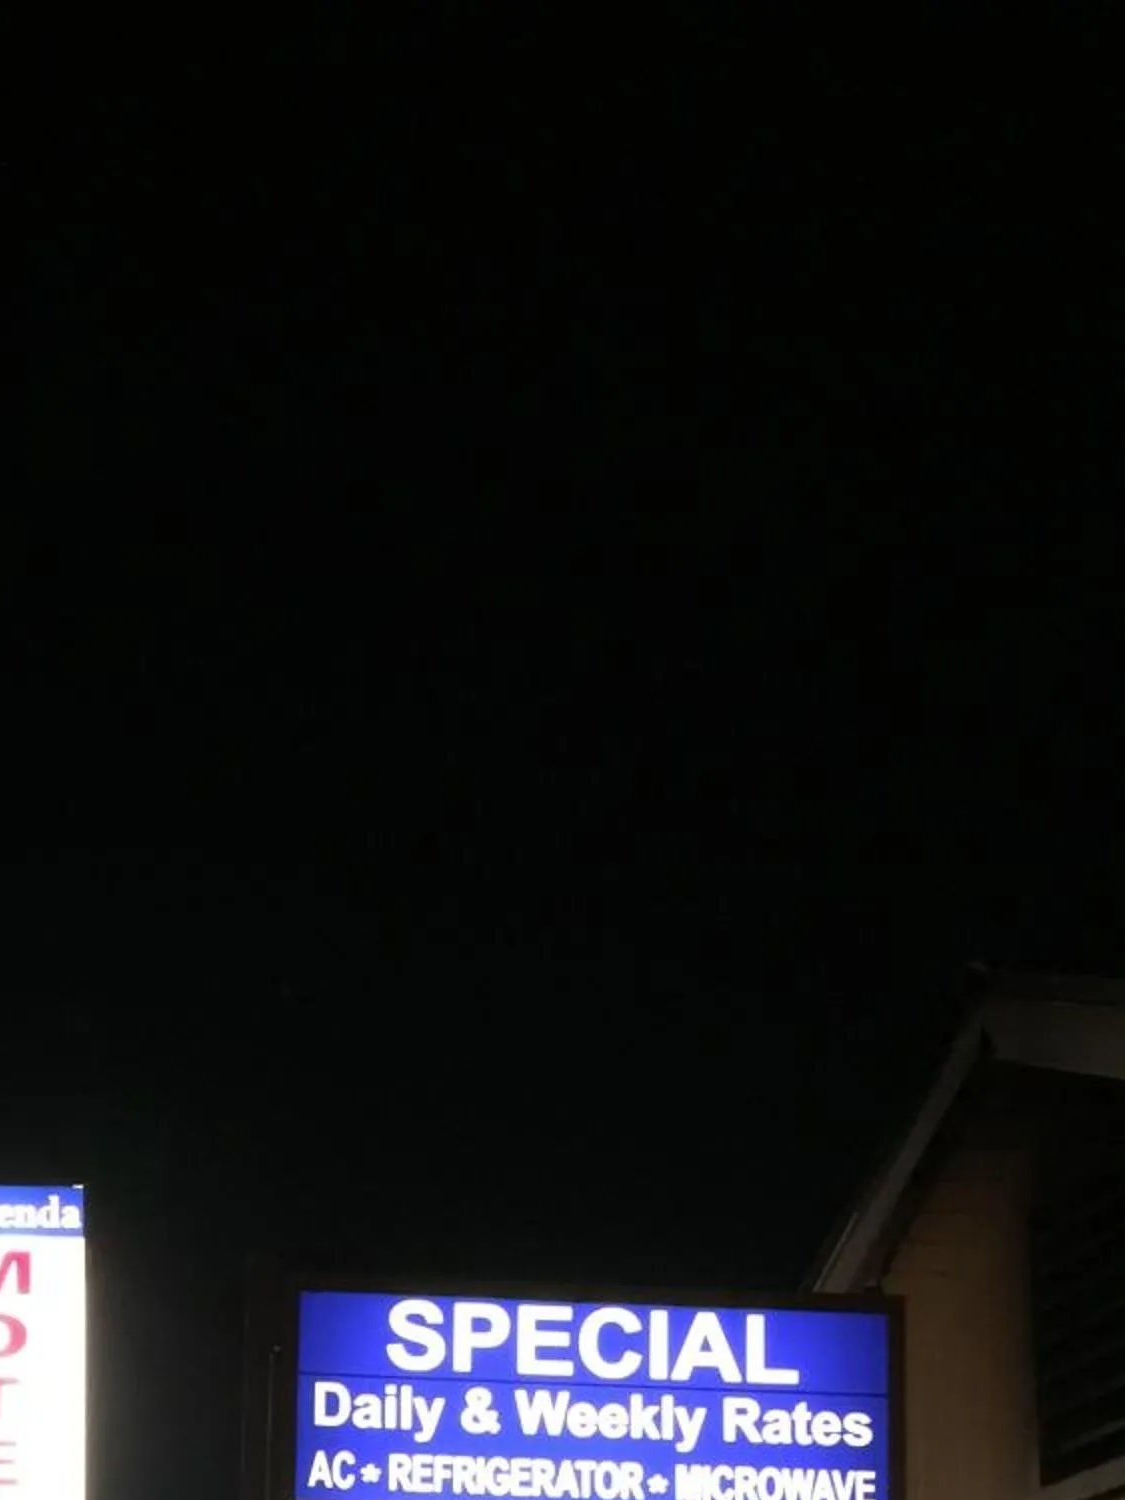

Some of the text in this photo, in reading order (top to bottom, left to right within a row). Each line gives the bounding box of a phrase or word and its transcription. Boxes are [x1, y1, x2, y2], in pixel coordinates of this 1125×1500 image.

[386, 1299, 800, 1385] SPECIAL
[312, 1381, 873, 1452] Daily & Weekly Rates
[308, 1451, 355, 1490] AC
[388, 1454, 645, 1500] REFRIGERATOR
